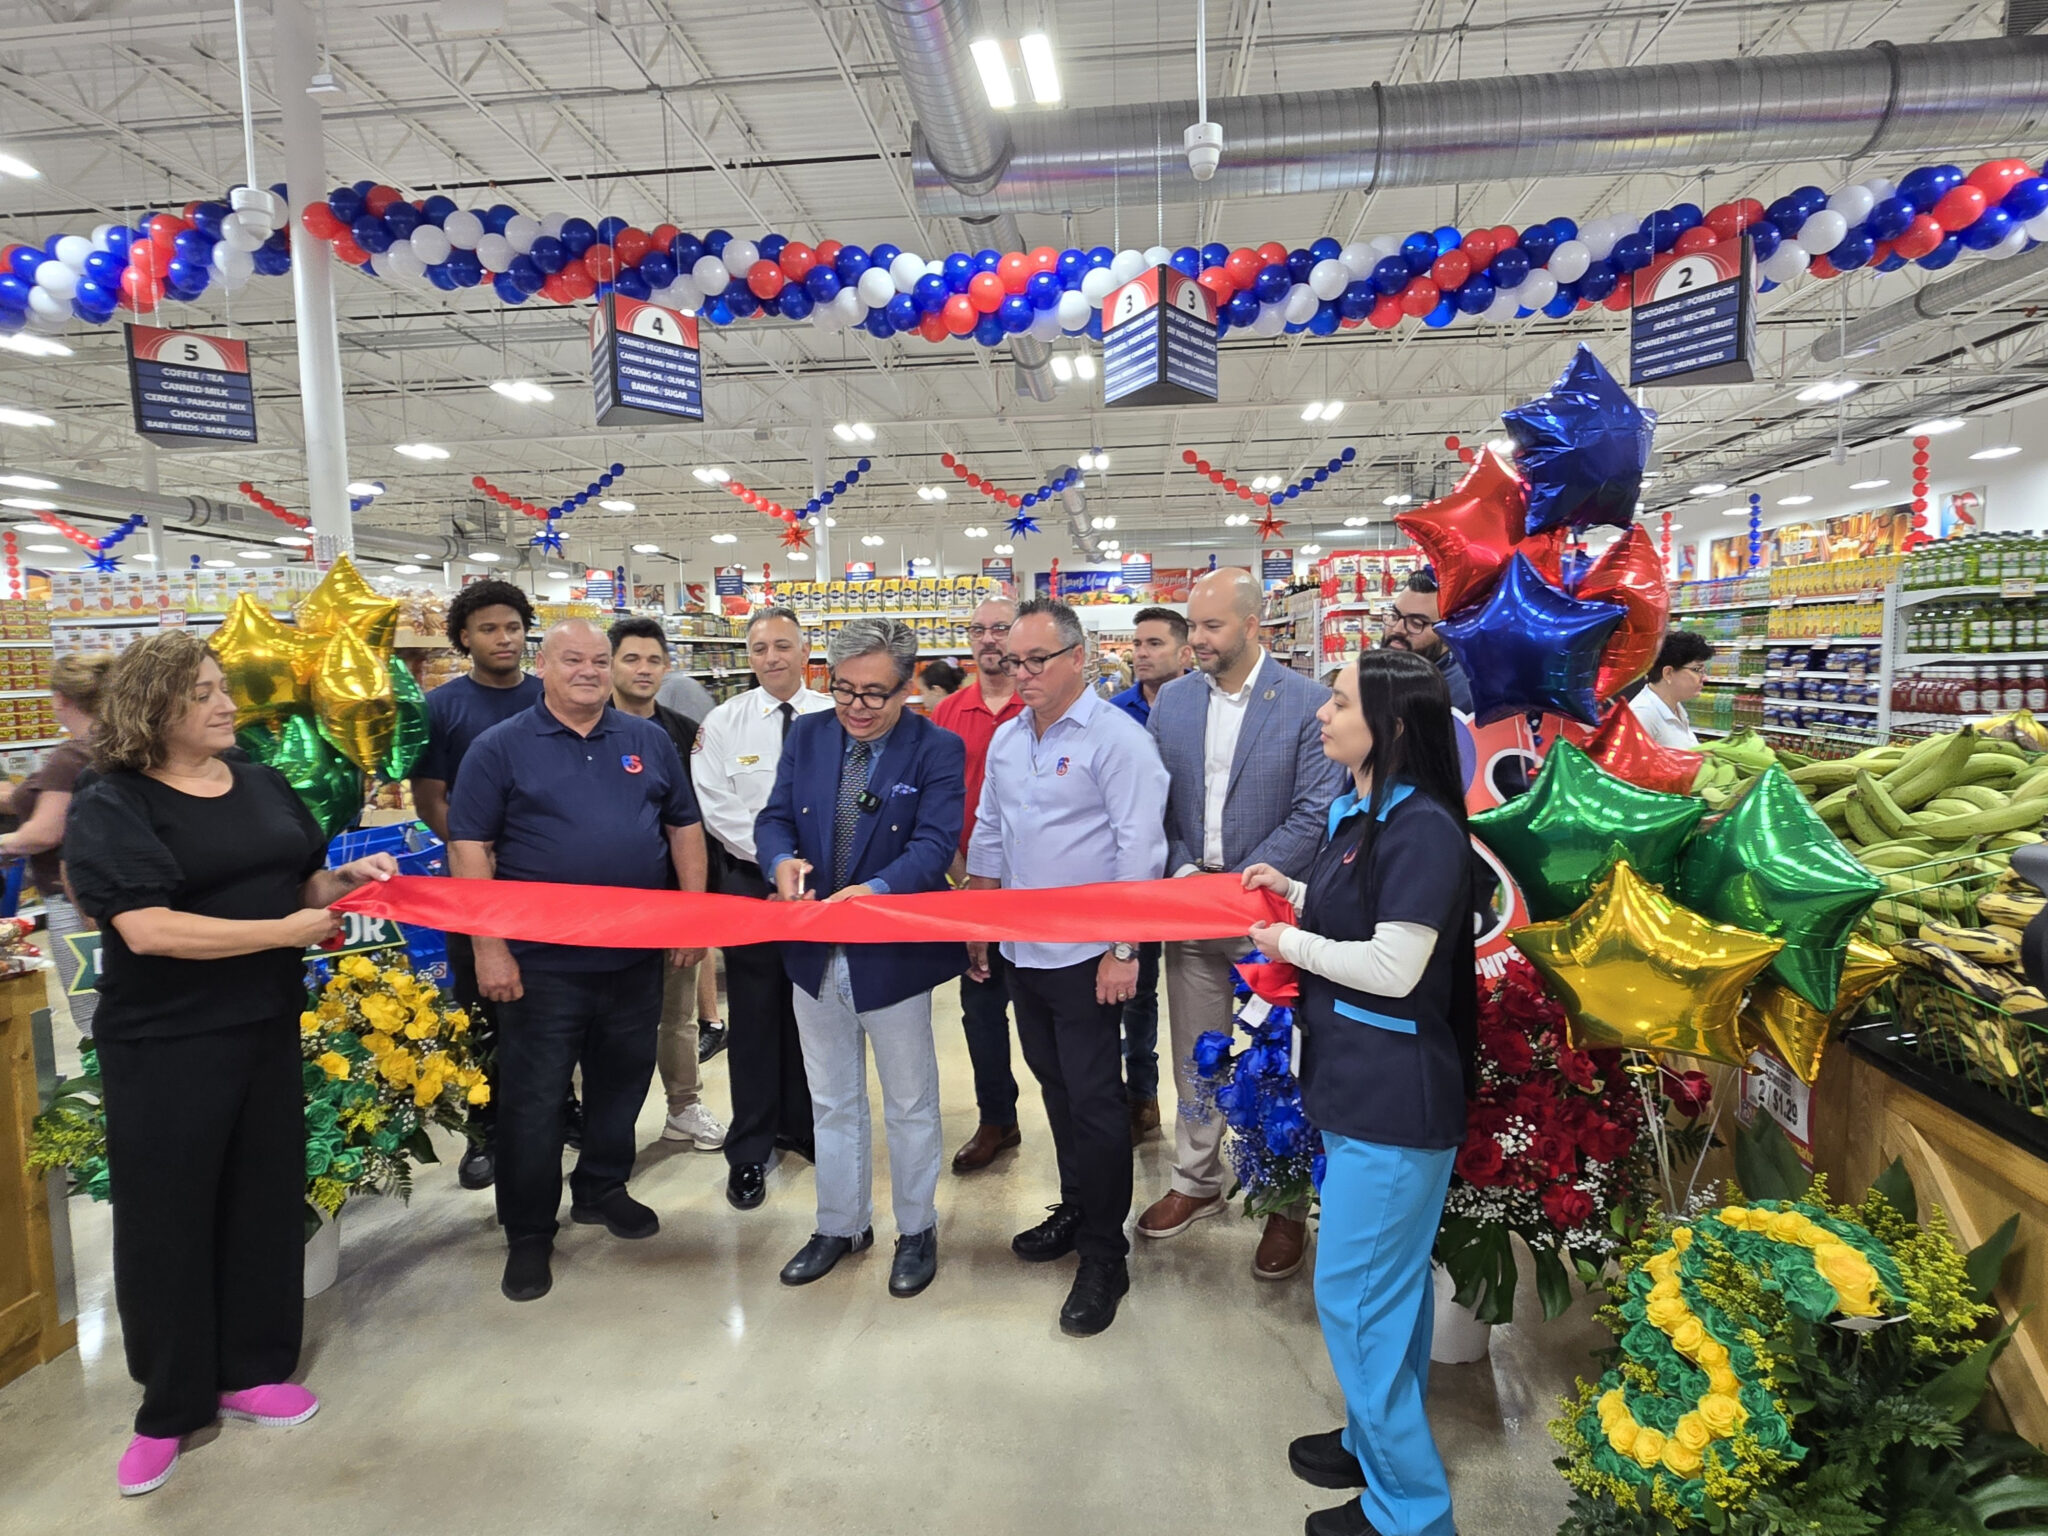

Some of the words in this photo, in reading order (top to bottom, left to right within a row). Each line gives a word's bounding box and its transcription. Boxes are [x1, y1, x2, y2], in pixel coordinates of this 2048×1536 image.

[1678, 267, 1692, 288] 2
[1188, 290, 1195, 309] 3
[1687, 286, 1734, 305] POWERADE
[1125, 295, 1132, 313] 3
[652, 317, 664, 335] 4
[184, 344, 199, 361] 5
[161, 368, 198, 378] COFFEE
[621, 366, 651, 378] COOKING
[160, 382, 200, 392] CANNED
[204, 387, 228, 395] MILK
[631, 382, 658, 393] BAKING
[664, 388, 687, 398] SUGAR
[144, 393, 179, 402] CEREAL
[187, 398, 227, 408] PANCAKE
[169, 410, 226, 421] CHOCOLATE
